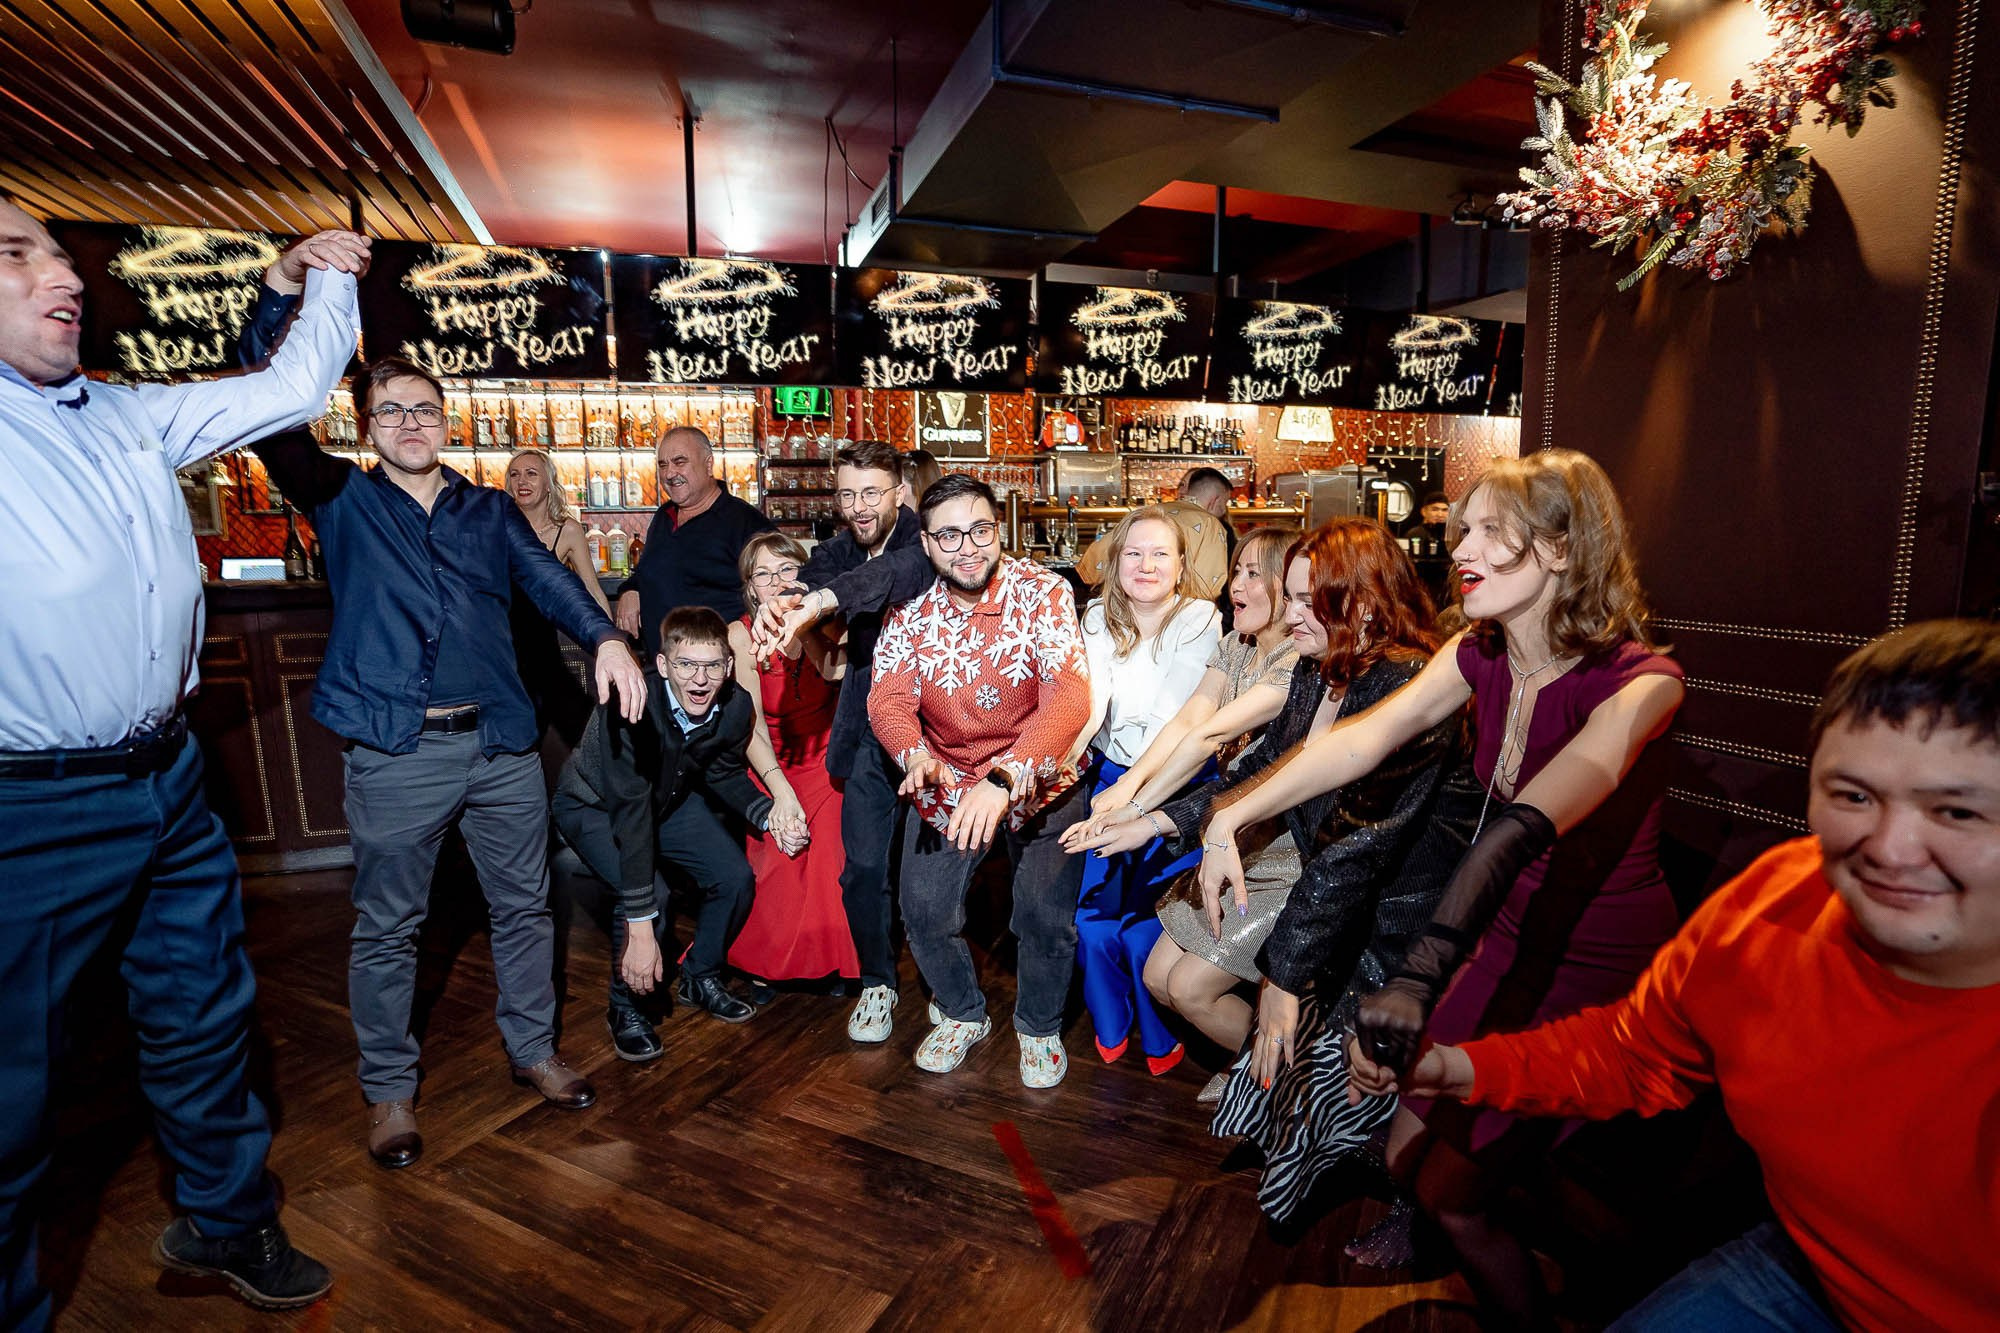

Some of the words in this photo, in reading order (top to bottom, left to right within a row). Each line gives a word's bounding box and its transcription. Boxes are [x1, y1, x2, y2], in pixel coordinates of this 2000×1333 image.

[427, 294, 541, 337] Happy
[672, 305, 774, 346] Happy
[887, 317, 978, 354] Happy
[114, 331, 226, 371] New
[401, 338, 495, 376] New
[503, 326, 594, 369] Year
[646, 348, 730, 383] New
[736, 333, 819, 376] Year
[1084, 329, 1166, 363] Happy
[1251, 341, 1323, 373] Happy
[862, 355, 937, 388] New
[943, 345, 1017, 382] Year
[1061, 365, 1127, 395] New
[1132, 355, 1199, 390] Year
[1229, 374, 1288, 403] New
[1293, 365, 1351, 398] Year
[1397, 352, 1462, 382] Happy
[1375, 383, 1428, 410] New
[1434, 373, 1485, 404] Year
